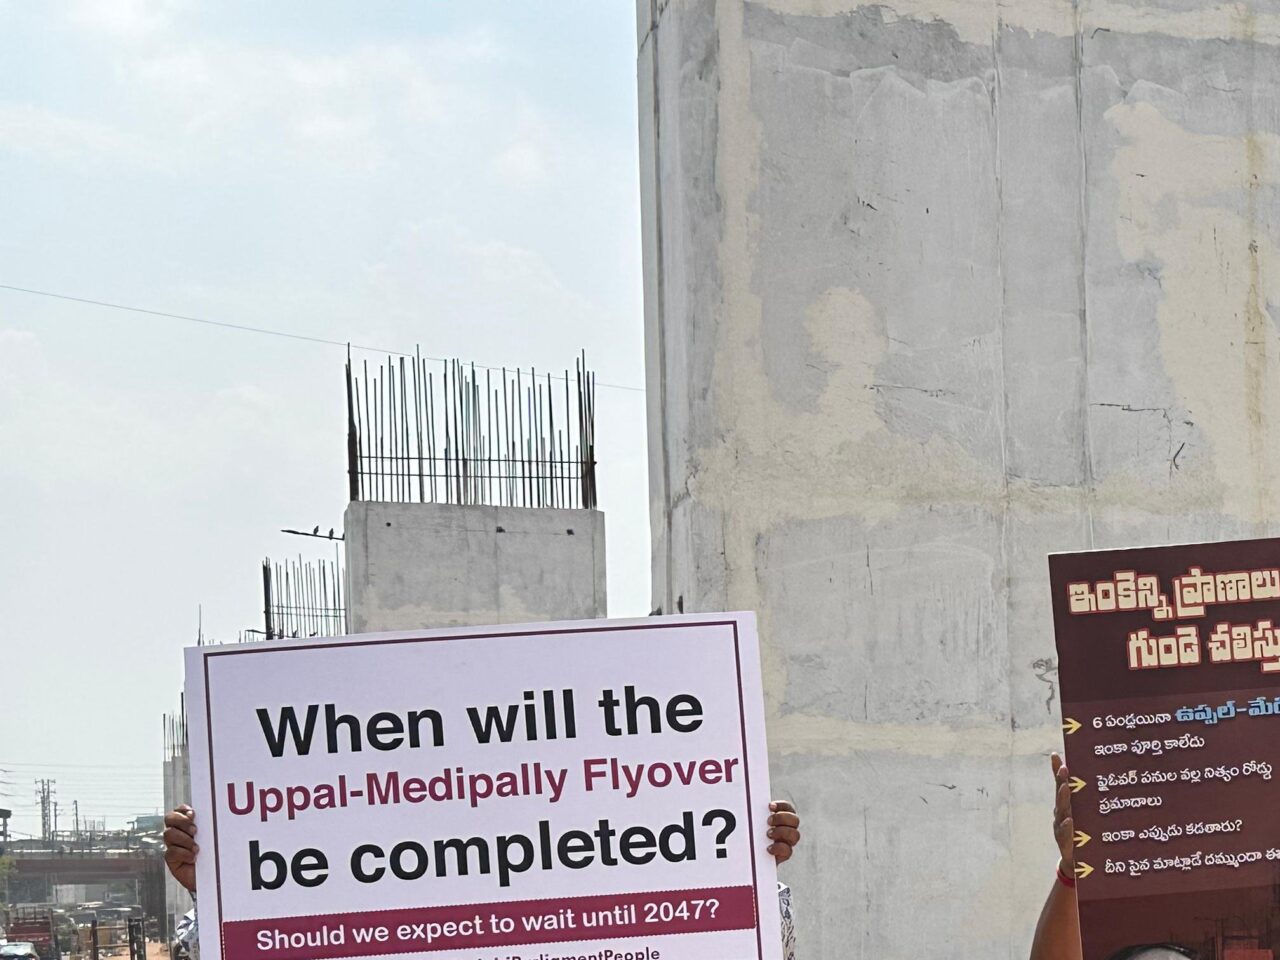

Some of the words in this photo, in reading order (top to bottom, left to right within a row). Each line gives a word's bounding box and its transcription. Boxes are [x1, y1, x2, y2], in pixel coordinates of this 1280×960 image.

[1068, 570, 1174, 620] ఇంకెన్ని
[1128, 628, 1200, 669] గుండె
[256, 704, 444, 758] When
[466, 689, 577, 744] will
[598, 685, 703, 736] the
[1093, 717, 1103, 729] 6
[1094, 742, 1128, 756] ఇంకా
[1130, 739, 1163, 756] పూర్తి
[1164, 733, 1205, 750] కాలేదు
[227, 762, 567, 823] Uppal-Medipally
[584, 757, 739, 798] Flyover
[1098, 795, 1163, 814] ప్రమాదాలు
[249, 839, 329, 890] be
[351, 809, 736, 886] completed?
[1101, 829, 1136, 842] ఇంకా
[1138, 824, 1183, 842] ఎప్పుడు
[1104, 858, 1126, 874] దీని
[257, 925, 344, 951] Should
[353, 926, 388, 943] we
[397, 915, 484, 944] expect
[490, 914, 515, 934] to
[522, 908, 576, 931] wait
[583, 904, 636, 927] until
[644, 899, 720, 924] 2047?
